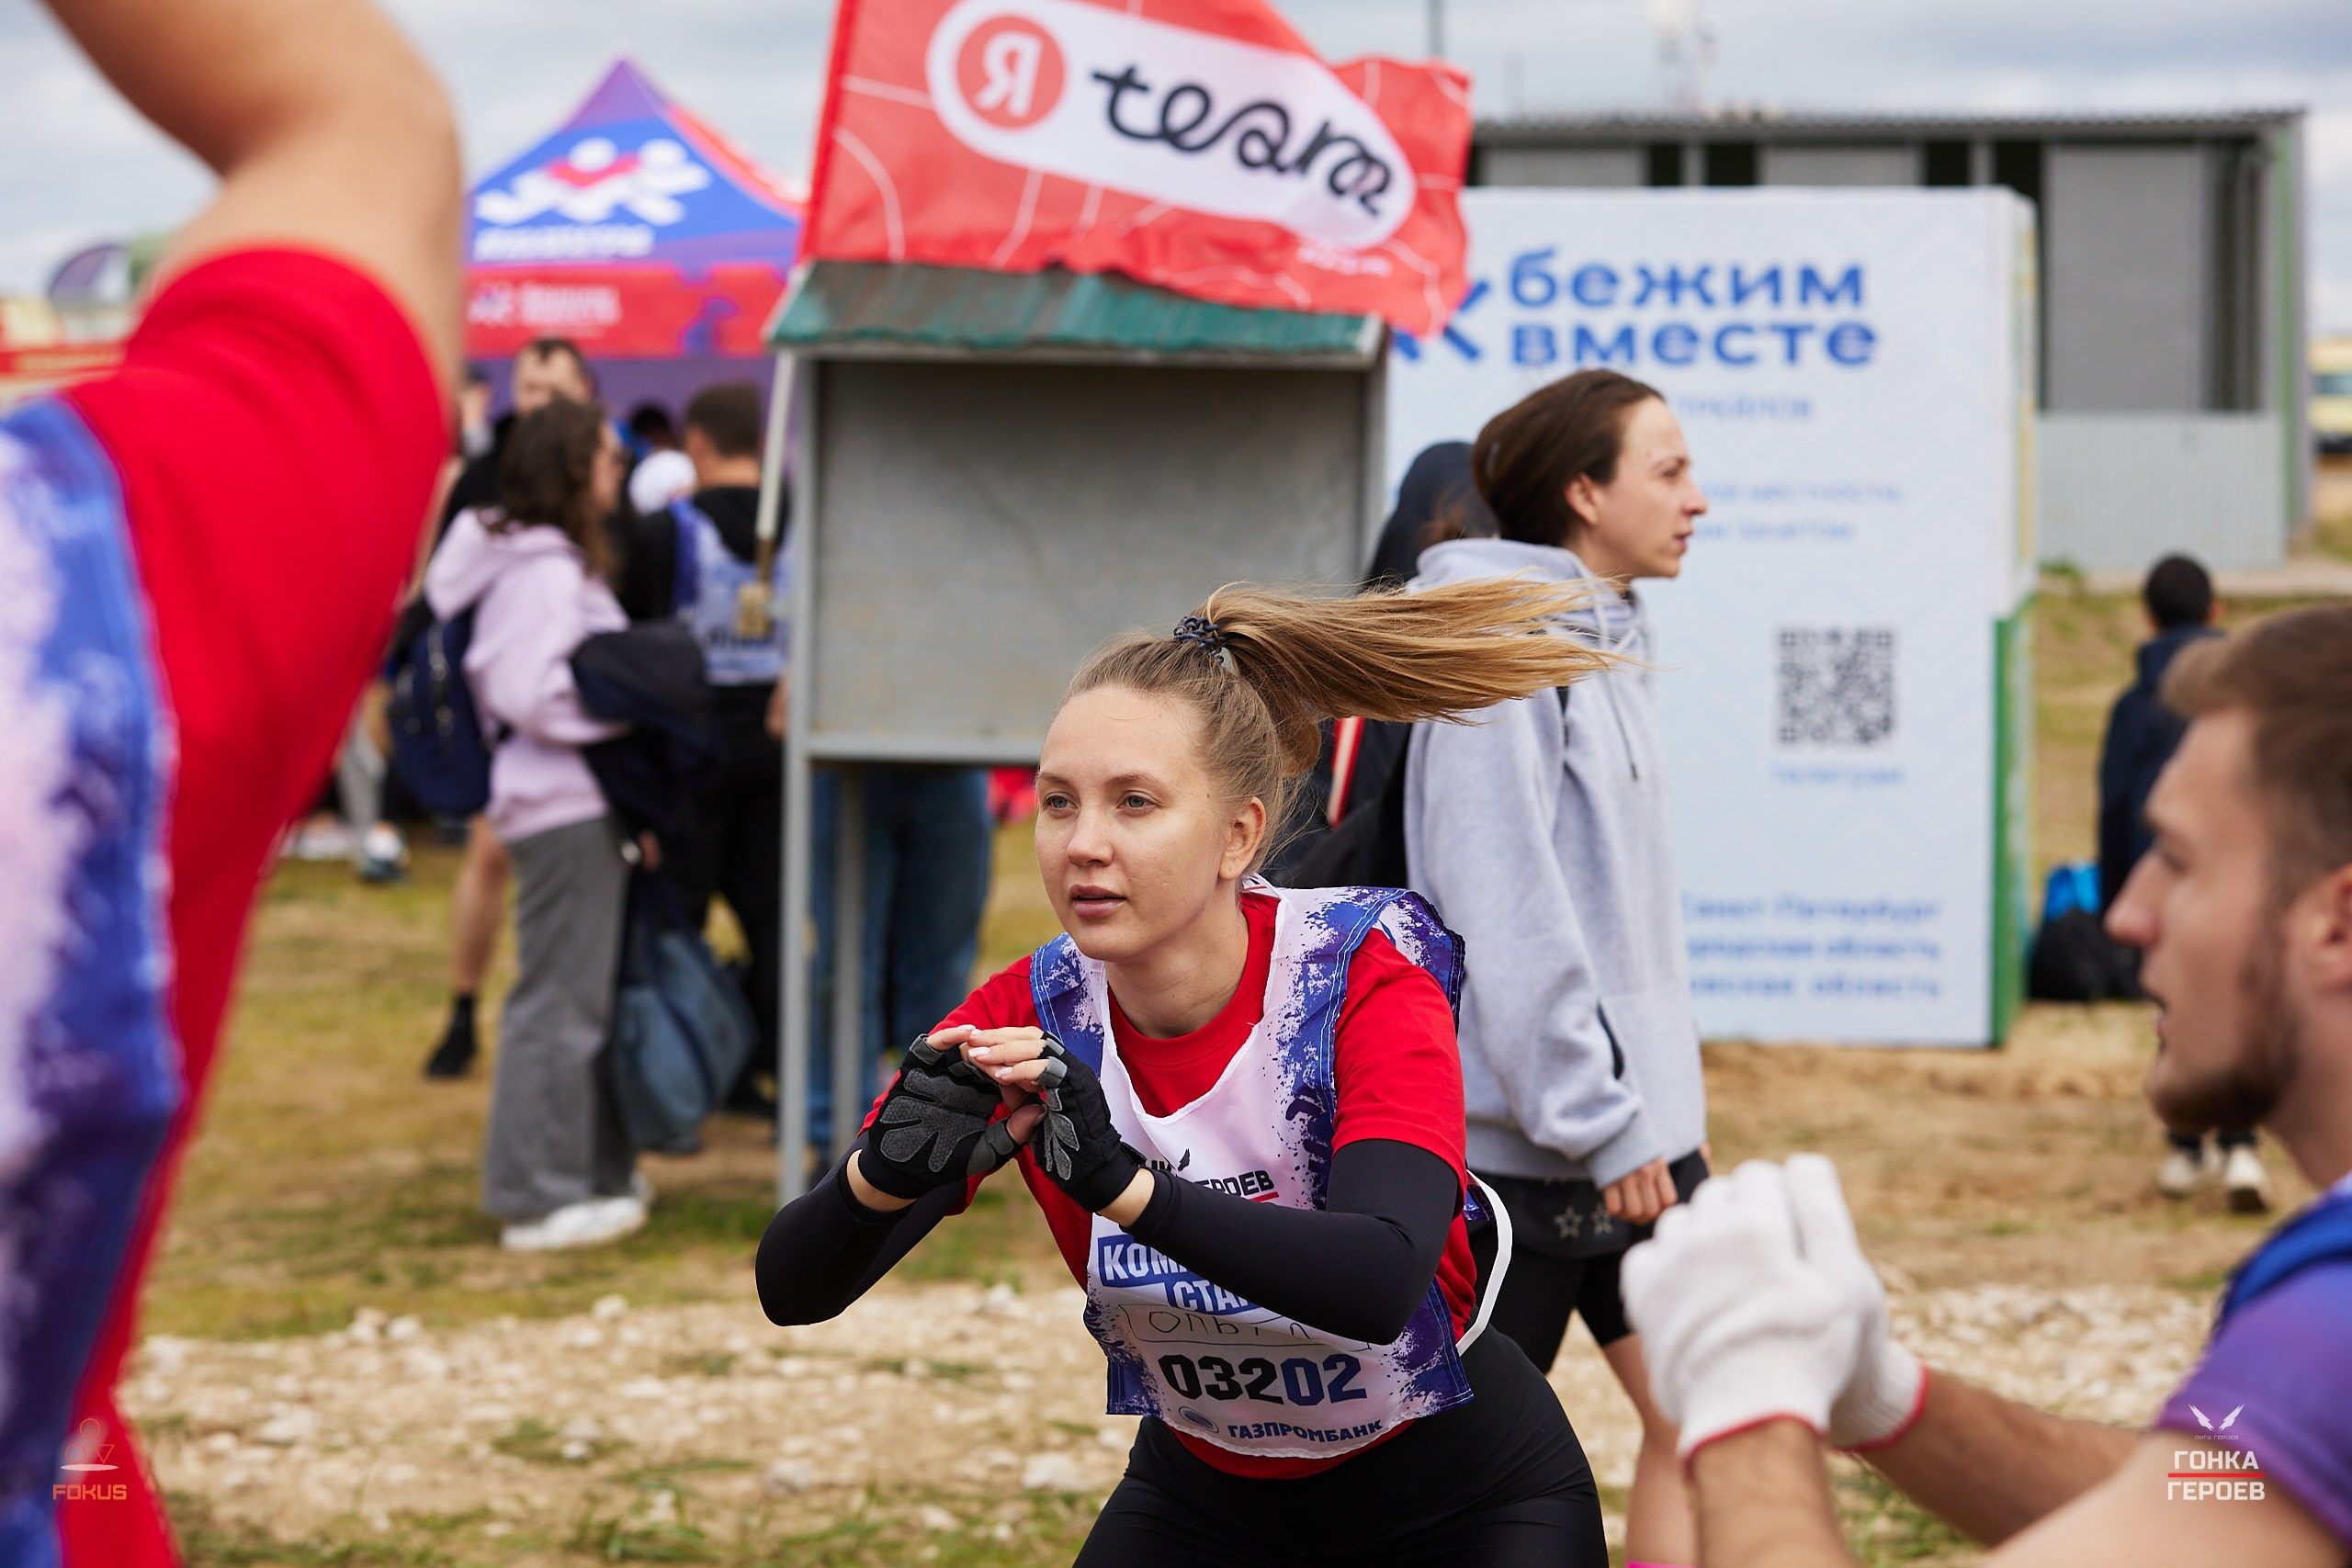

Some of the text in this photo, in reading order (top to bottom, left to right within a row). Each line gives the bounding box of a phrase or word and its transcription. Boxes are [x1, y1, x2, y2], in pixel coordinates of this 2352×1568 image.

[978, 32, 1393, 218] Я team
[1509, 245, 1865, 309] бежим
[1510, 321, 1878, 367] вместе
[1103, 1243, 1188, 1280] КОМ
[1172, 1280, 1250, 1313] СТА
[1158, 1353, 1368, 1406] 03202
[1227, 1419, 1384, 1443] ГАЗПРОМБАНК
